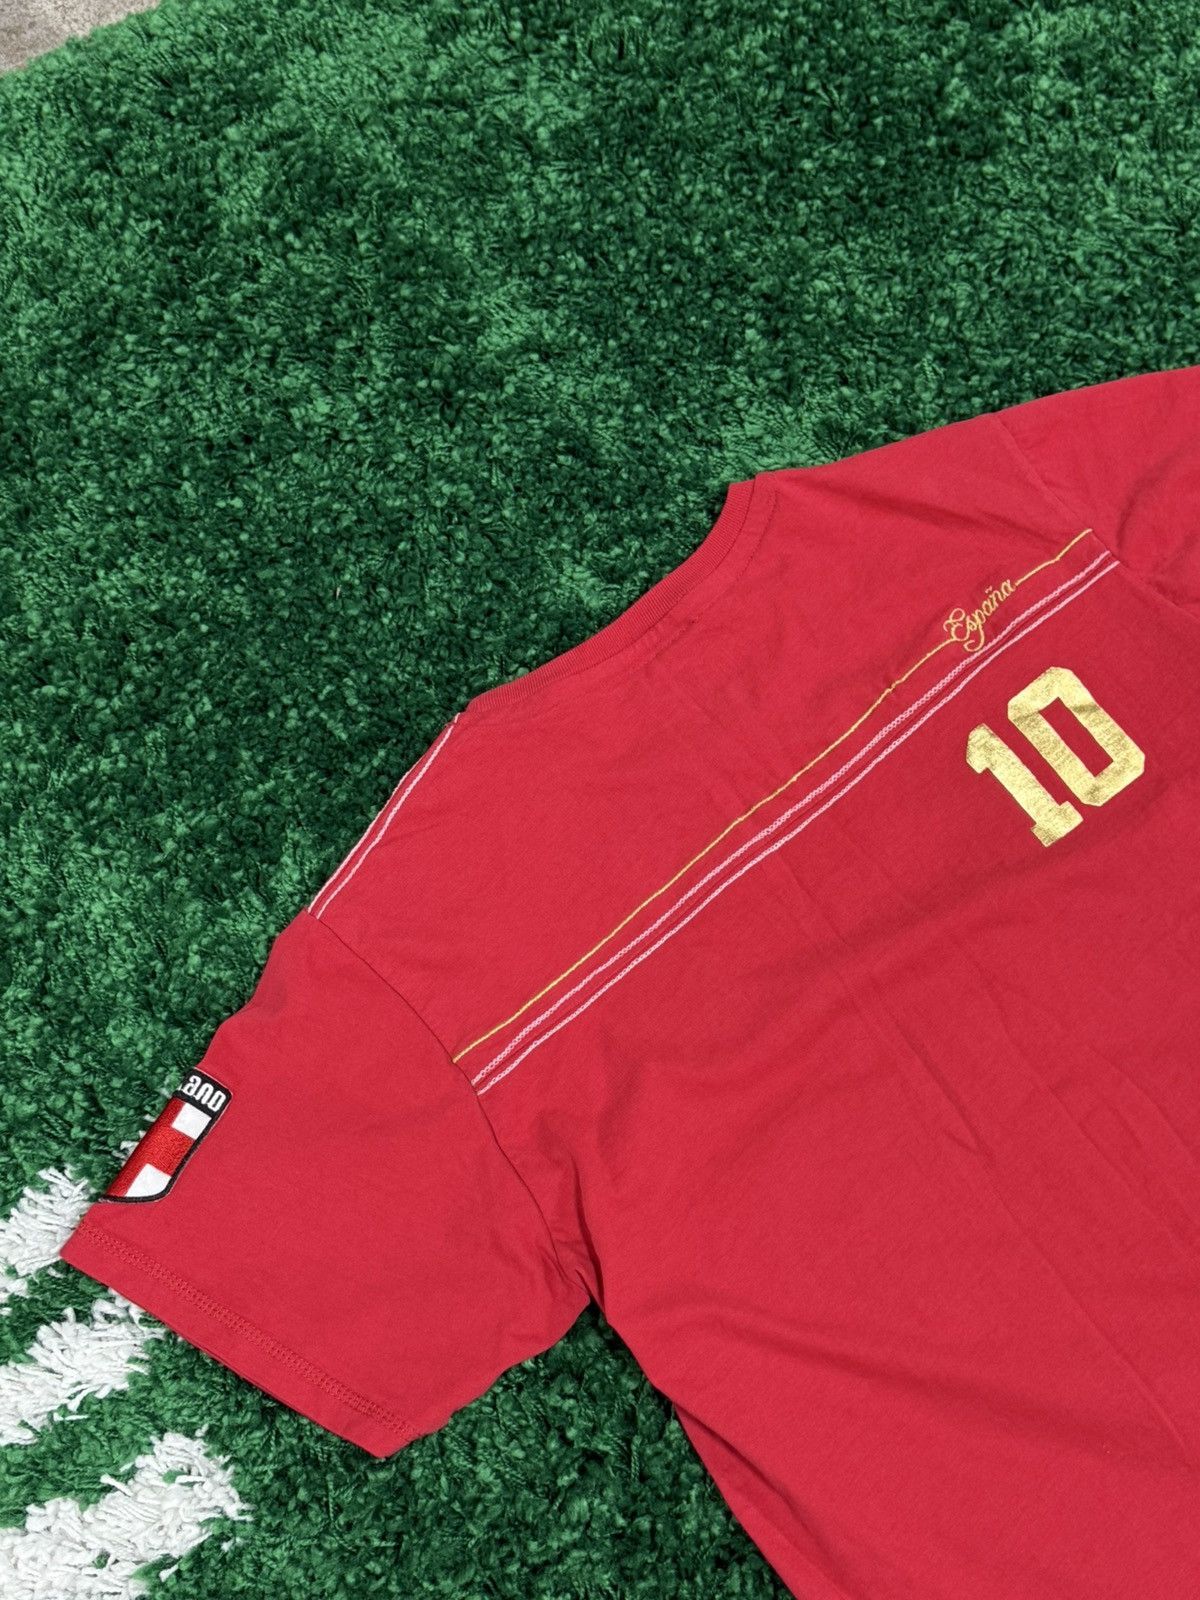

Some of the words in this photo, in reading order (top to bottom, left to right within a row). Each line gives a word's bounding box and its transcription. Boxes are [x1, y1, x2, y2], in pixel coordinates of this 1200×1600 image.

[943, 579, 1016, 652] España
[966, 667, 1145, 847] 10
[178, 1075, 227, 1113] ano
